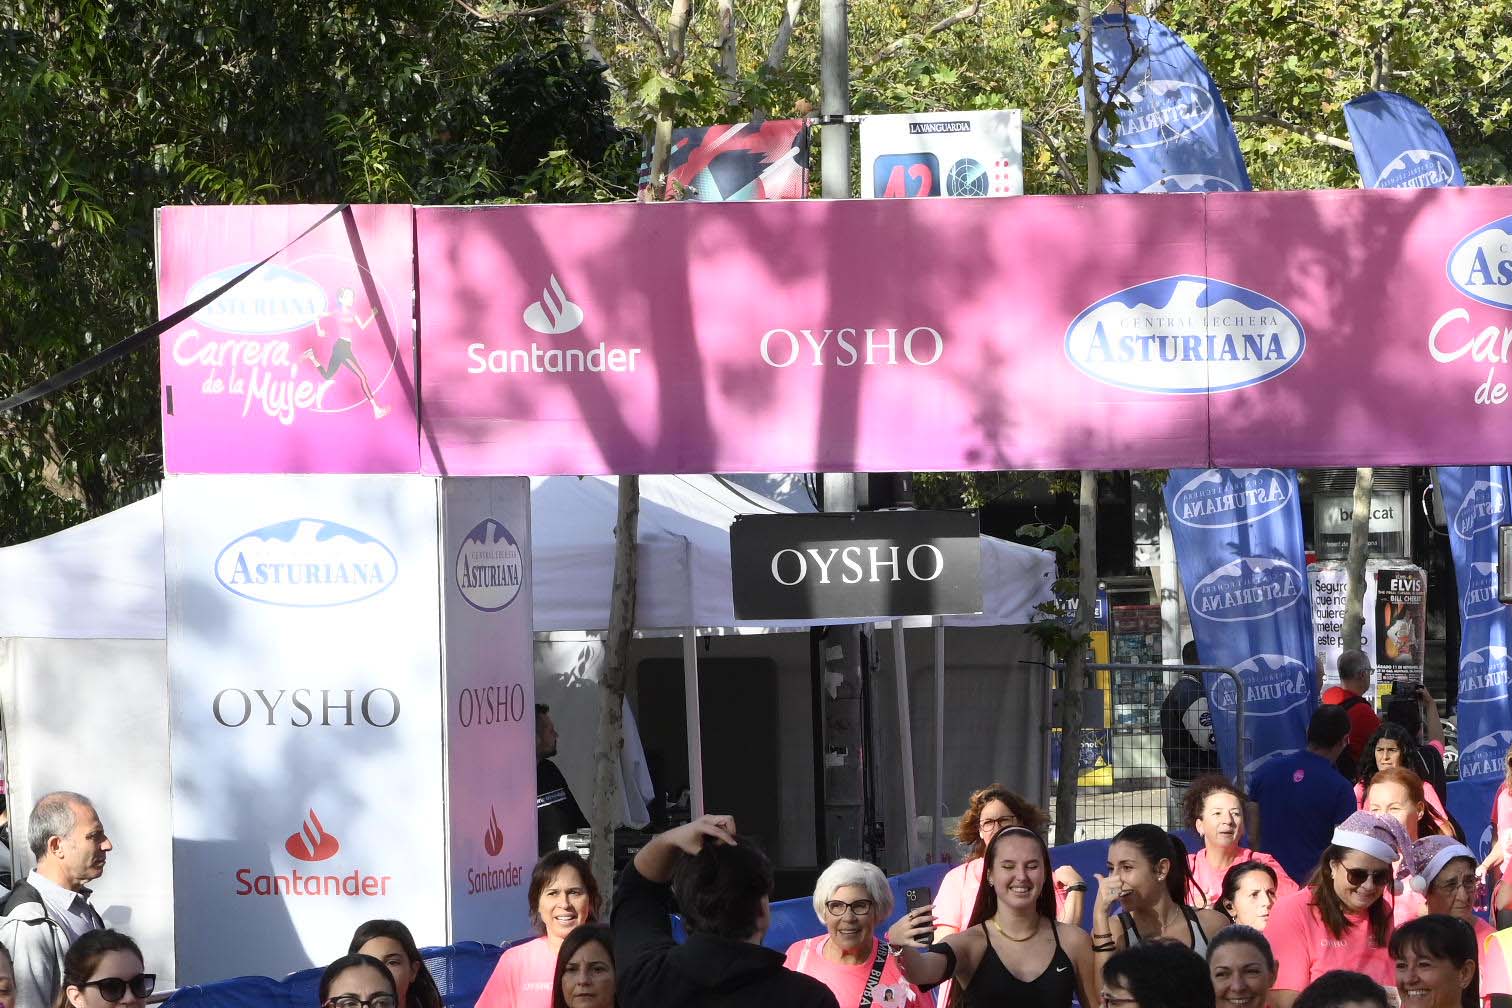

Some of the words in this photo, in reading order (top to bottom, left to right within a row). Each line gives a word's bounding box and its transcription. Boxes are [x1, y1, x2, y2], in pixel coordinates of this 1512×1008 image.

[911, 124, 921, 132] LA
[921, 122, 969, 132] VANGUARDIA
[1203, 315, 1279, 327] LECHERA
[172, 328, 291, 369] Carrera
[466, 342, 640, 374] Santander
[759, 326, 943, 368] OYSHO
[1086, 320, 1287, 362] ASTURIANA
[202, 368, 225, 396] de
[228, 366, 244, 395] la
[242, 365, 336, 425] Mujer
[1474, 367, 1508, 405] de
[230, 551, 385, 584] ASTURIANA
[461, 553, 519, 588] ASTURIANA
[771, 544, 944, 586] OYSHO
[1316, 595, 1333, 608] que
[1390, 579, 1421, 591] ELVIS
[1317, 635, 1335, 646] este
[212, 687, 401, 728] OYSHO
[457, 683, 525, 728] OYSHO
[235, 867, 392, 897] Santander
[467, 862, 523, 895] Santander
[875, 941, 888, 963] MBA
[859, 968, 882, 1006] BIMBA
